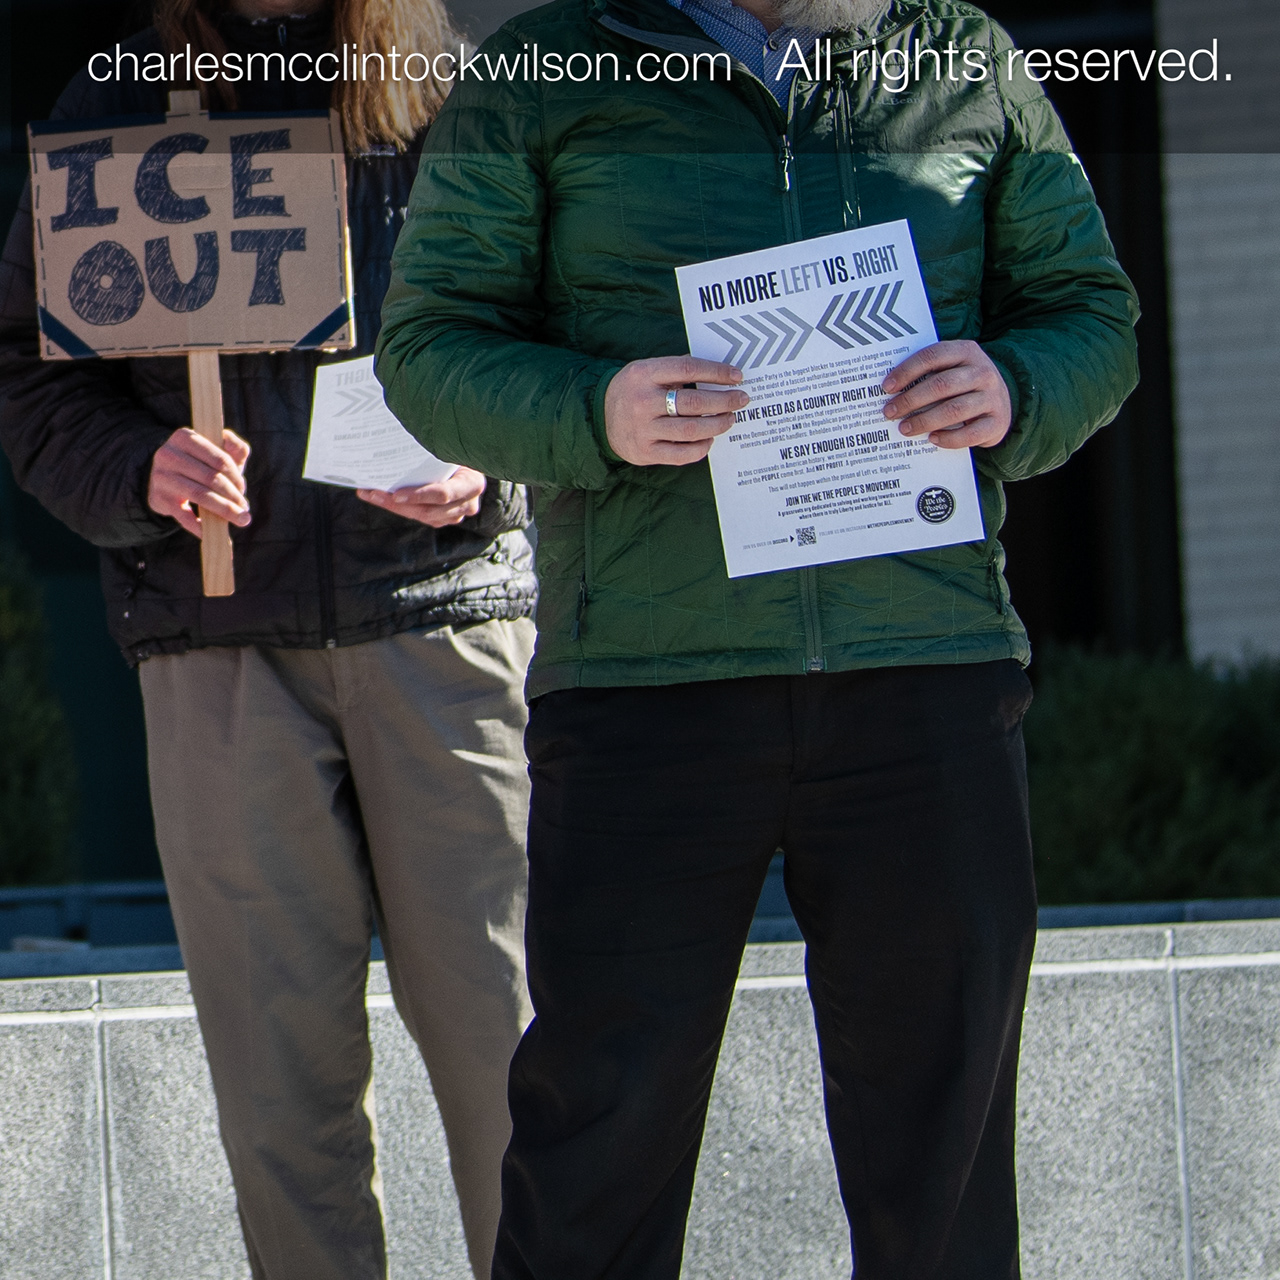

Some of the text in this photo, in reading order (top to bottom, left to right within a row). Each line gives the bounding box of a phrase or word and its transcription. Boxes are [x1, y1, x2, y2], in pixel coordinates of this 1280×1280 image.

[47, 129, 292, 232] ICE
[67, 227, 306, 326] OUT
[699, 245, 899, 312] NO MORE LEFT VS. RIGHT
[840, 373, 868, 384] SOCIALISM
[733, 410, 747, 423] AT
[747, 408, 761, 420] WE
[761, 404, 783, 418] NEED
[784, 401, 795, 414] AS
[796, 400, 803, 411] A
[803, 393, 841, 410] COUNTRY
[842, 387, 867, 402] RIGHT
[780, 430, 890, 460] WE SAY ENOUGH IS ENOUGH
[855, 447, 870, 456] STAND
[888, 442, 903, 450] FIGHT
[761, 473, 780, 482] PEOPLE
[785, 479, 900, 506] JOIN THE WE THE PEOPLE'S MOVEMENT
